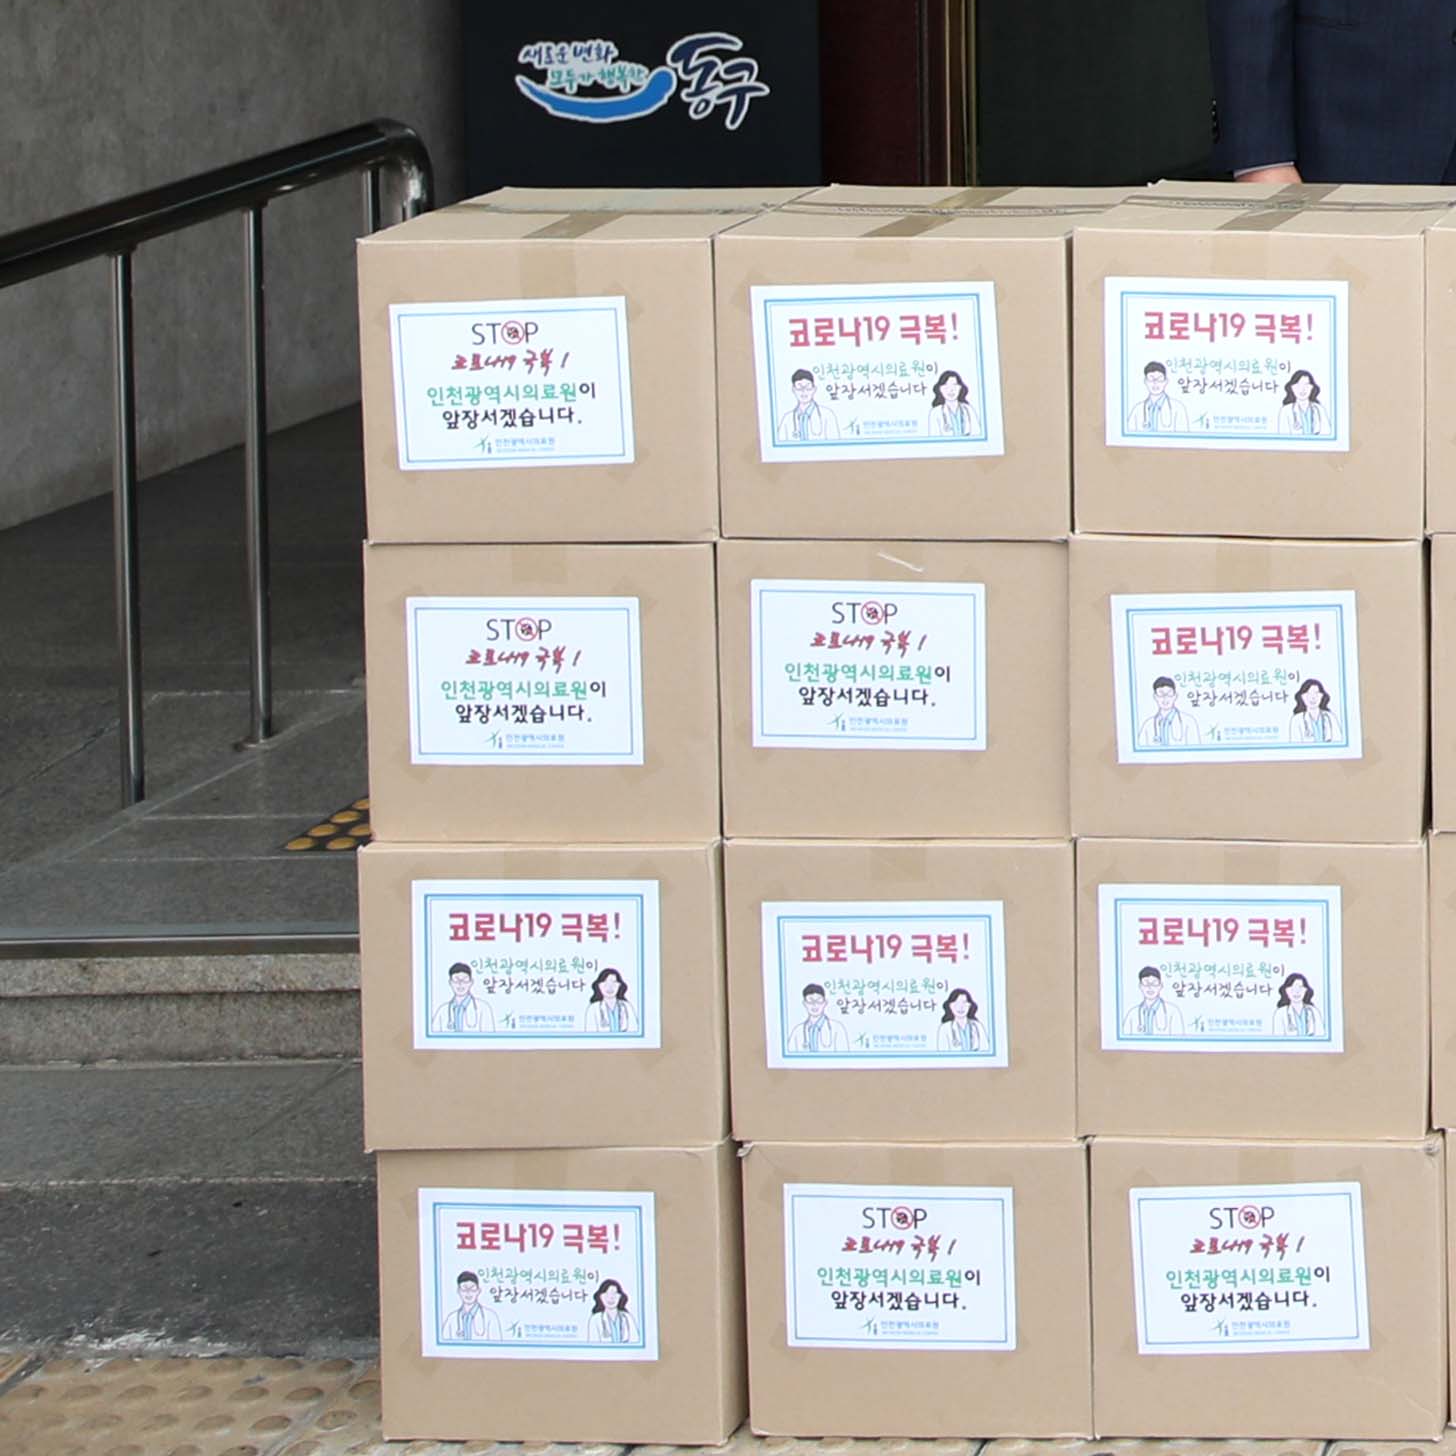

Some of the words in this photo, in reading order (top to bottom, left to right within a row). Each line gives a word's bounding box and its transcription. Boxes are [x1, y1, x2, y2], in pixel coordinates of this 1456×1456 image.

[572, 41, 617, 65] 변화
[668, 33, 769, 129] 동구
[788, 315, 892, 349] 코로나19
[898, 312, 959, 345] 극복!
[1144, 311, 1246, 342] 코로나19
[1254, 312, 1313, 344] 극복!
[426, 382, 596, 407] 인천광역시의료원이
[442, 406, 582, 430] 앞장서겠습니다.
[1151, 625, 1254, 657] 코로나19
[1261, 623, 1322, 654] 극복!
[784, 661, 950, 685] 인천광역시의료원이
[440, 680, 606, 701] 인천광역시의료원이
[799, 686, 936, 709] 앞장서겠습니다.
[455, 704, 592, 724] 앞장서겠습니다.
[449, 912, 552, 943] 코로나19
[560, 912, 621, 942] 극복!
[1138, 917, 1240, 947] 코로나19
[1247, 917, 1307, 947] 극복!
[801, 933, 903, 964] 코로나19
[910, 933, 970, 963] 극복!
[455, 1222, 555, 1253] 코로나19
[562, 1223, 620, 1254] 극복!
[816, 1266, 980, 1289] 인천광역시의료원이
[1166, 1265, 1331, 1290] 인천광역시의료원이
[831, 1290, 966, 1312] 앞장서겠습니다.
[1181, 1290, 1317, 1312] 앞장서겠습니다.
